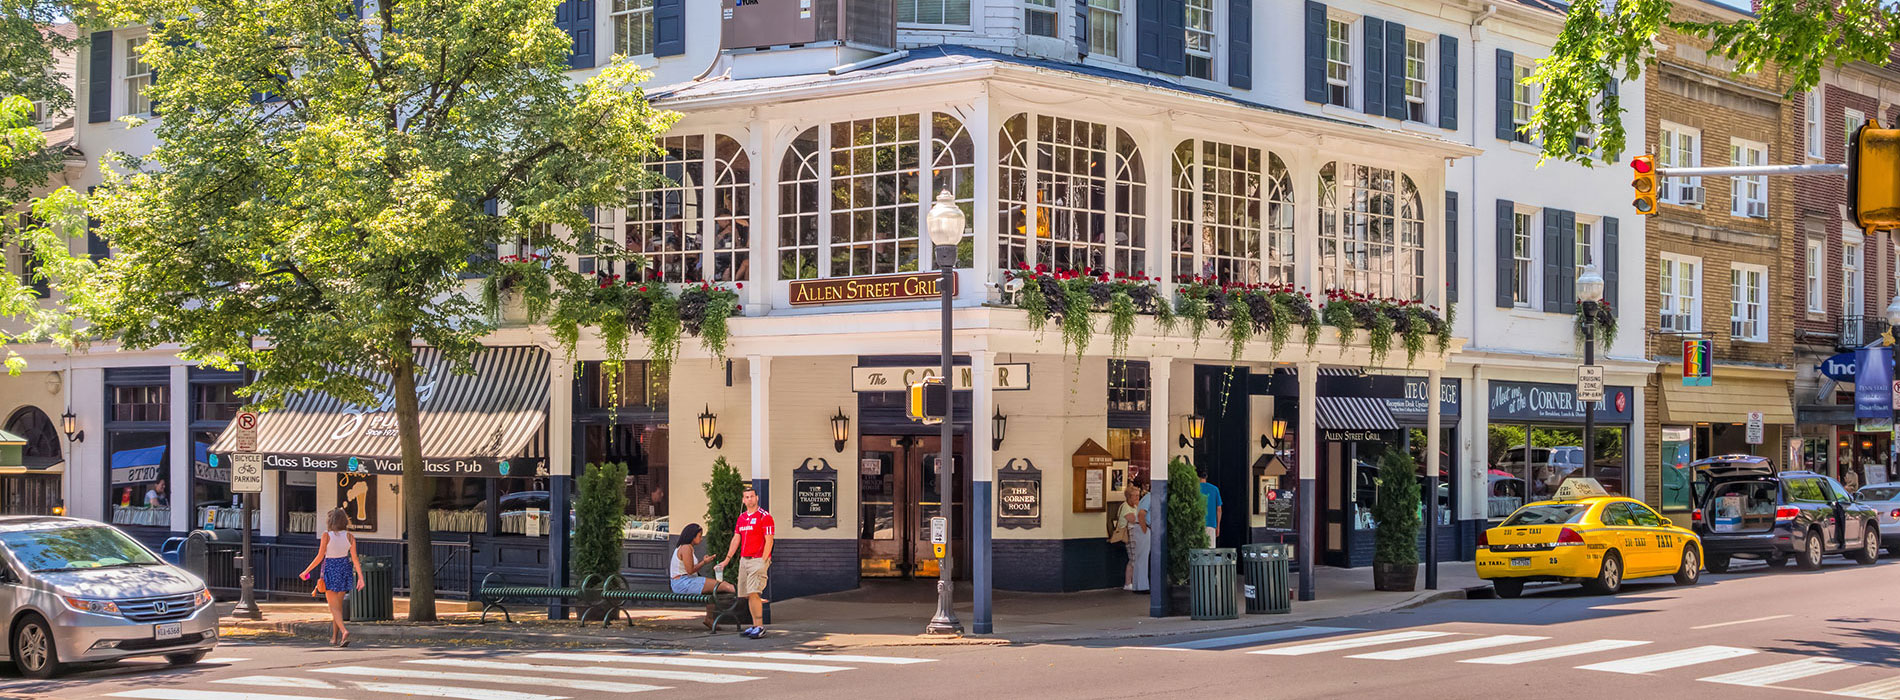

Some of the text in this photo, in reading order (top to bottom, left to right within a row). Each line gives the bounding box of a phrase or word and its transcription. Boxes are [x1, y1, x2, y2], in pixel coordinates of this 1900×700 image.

[796, 277, 941, 301] ALLEN STREET GRIL
[868, 373, 887, 386] The
[1491, 386, 1521, 409] Meet me
[1509, 394, 1527, 414] at the
[1529, 387, 1572, 411] CORNER
[1325, 430, 1381, 441] ALLEN STREET GRILL
[302, 456, 338, 468] Beers
[456, 459, 482, 473] Pub
[234, 475, 260, 483] PARKING
[1004, 495, 1035, 503] CORNER
[1635, 538, 1646, 546] TAXI
[1656, 535, 1673, 548] TAXI
